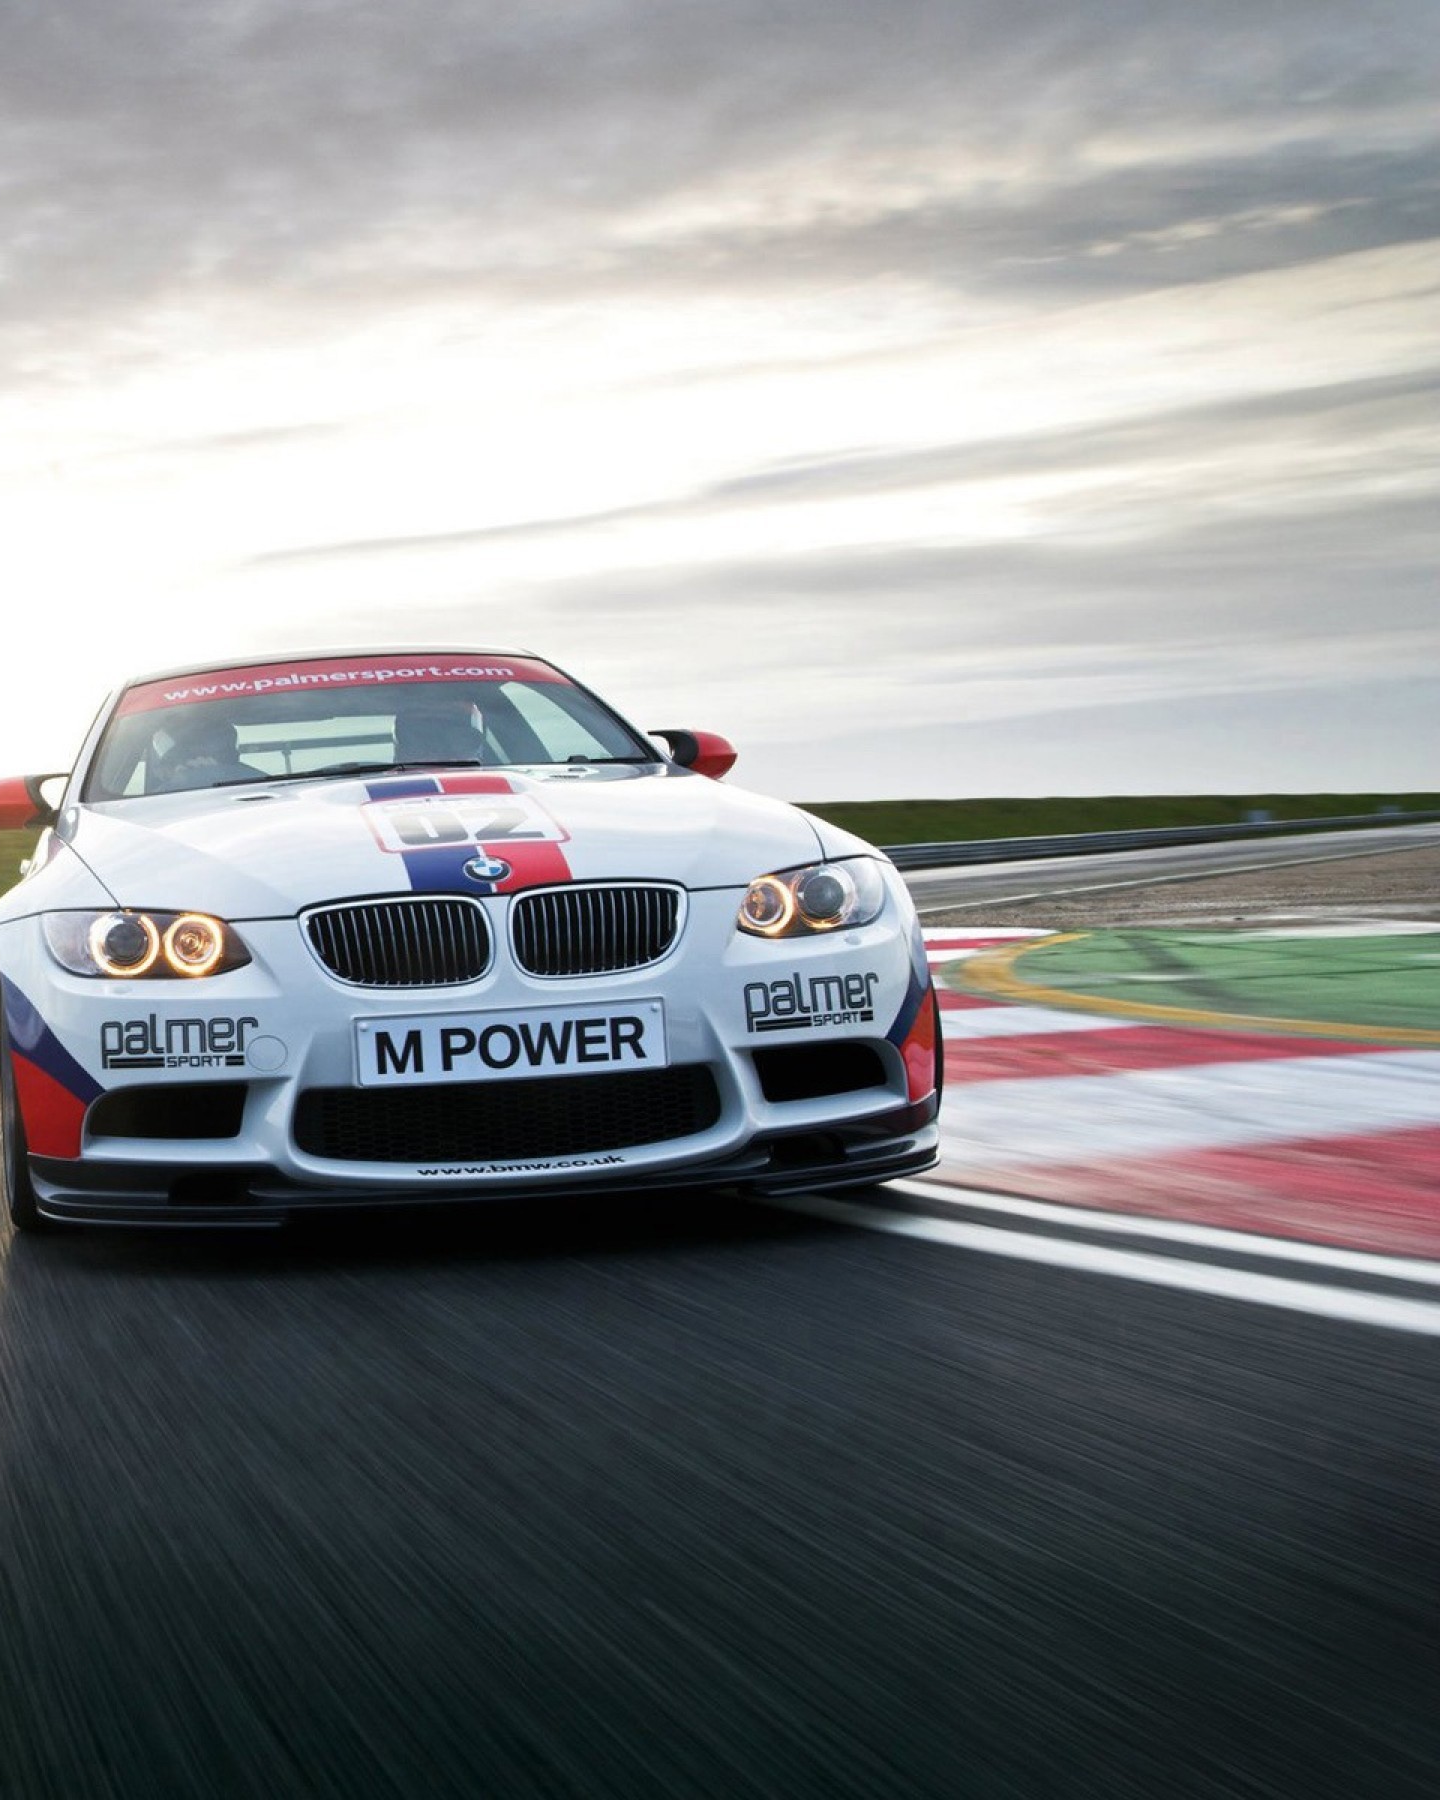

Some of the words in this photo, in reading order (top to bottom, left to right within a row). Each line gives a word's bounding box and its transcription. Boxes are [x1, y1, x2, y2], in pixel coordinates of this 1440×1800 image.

[162, 665, 514, 701] www.palmersport.com
[389, 808, 545, 846] 02
[743, 971, 880, 1033] palmer
[812, 1011, 860, 1027] SPORT
[100, 1013, 259, 1069] palmer
[375, 1029, 425, 1075] M
[440, 1015, 648, 1070] POWER
[166, 1055, 224, 1069] SPORT
[416, 1154, 626, 1177] www.bmw.co.uk
